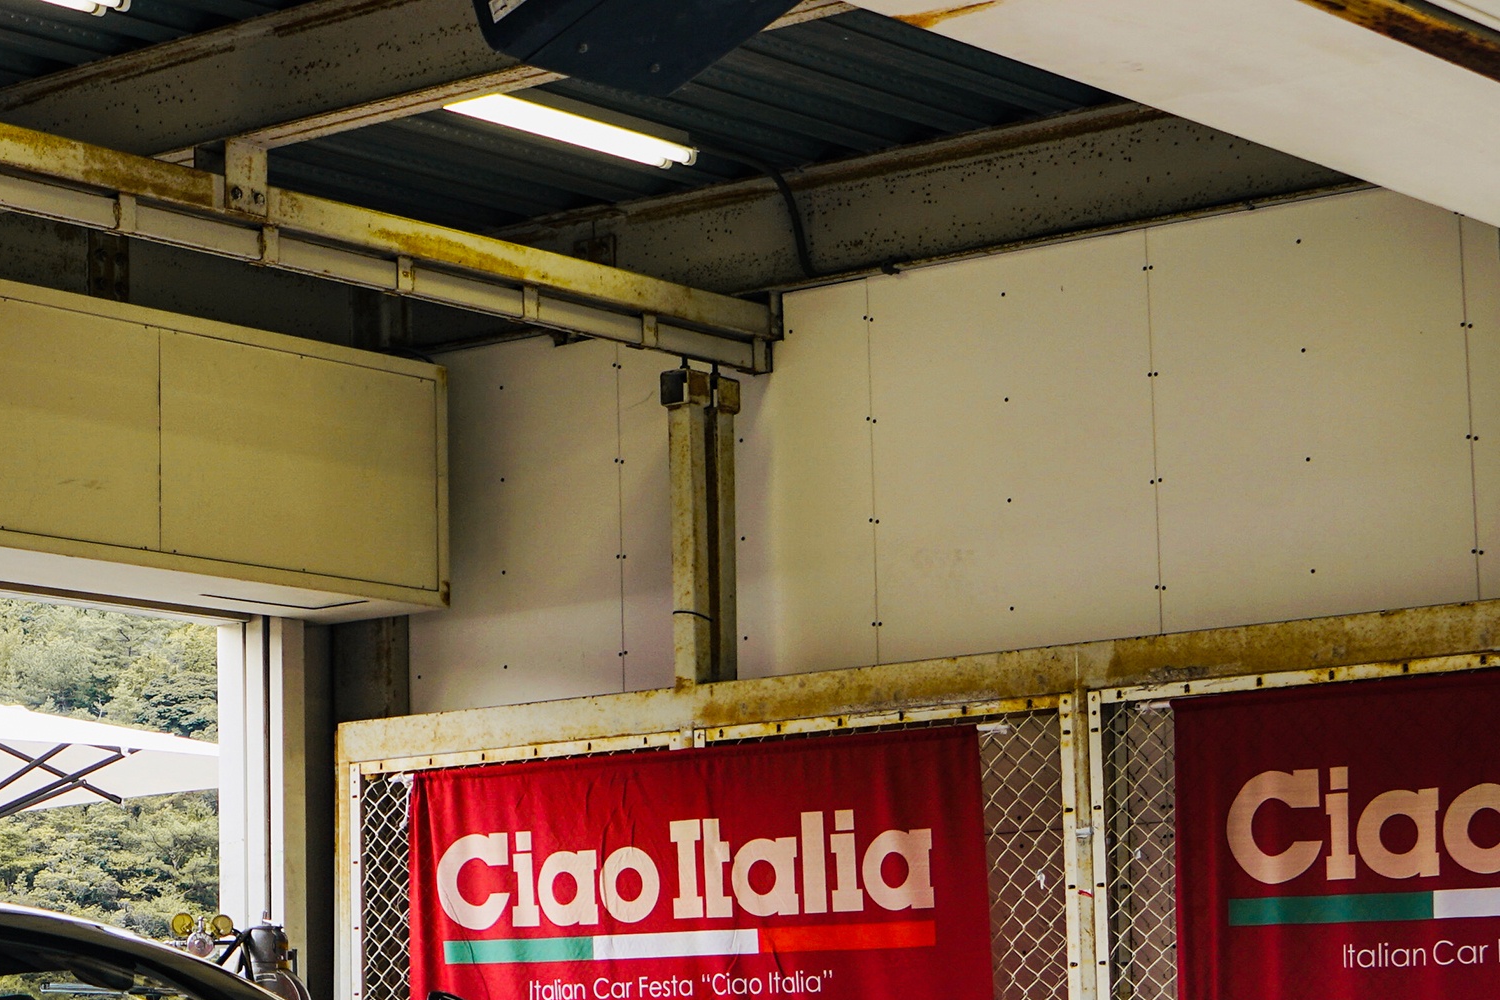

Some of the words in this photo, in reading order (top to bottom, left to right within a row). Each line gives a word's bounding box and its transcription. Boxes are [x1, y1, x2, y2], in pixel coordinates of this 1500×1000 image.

[1226, 766, 1500, 884] Ciao
[436, 831, 660, 930] Ciao
[669, 809, 935, 920] Italia
[528, 979, 586, 1000] Italian
[593, 977, 633, 999] Car
[638, 974, 693, 998] Festa
[1342, 942, 1426, 968] Italian
[1432, 939, 1489, 966] Car
